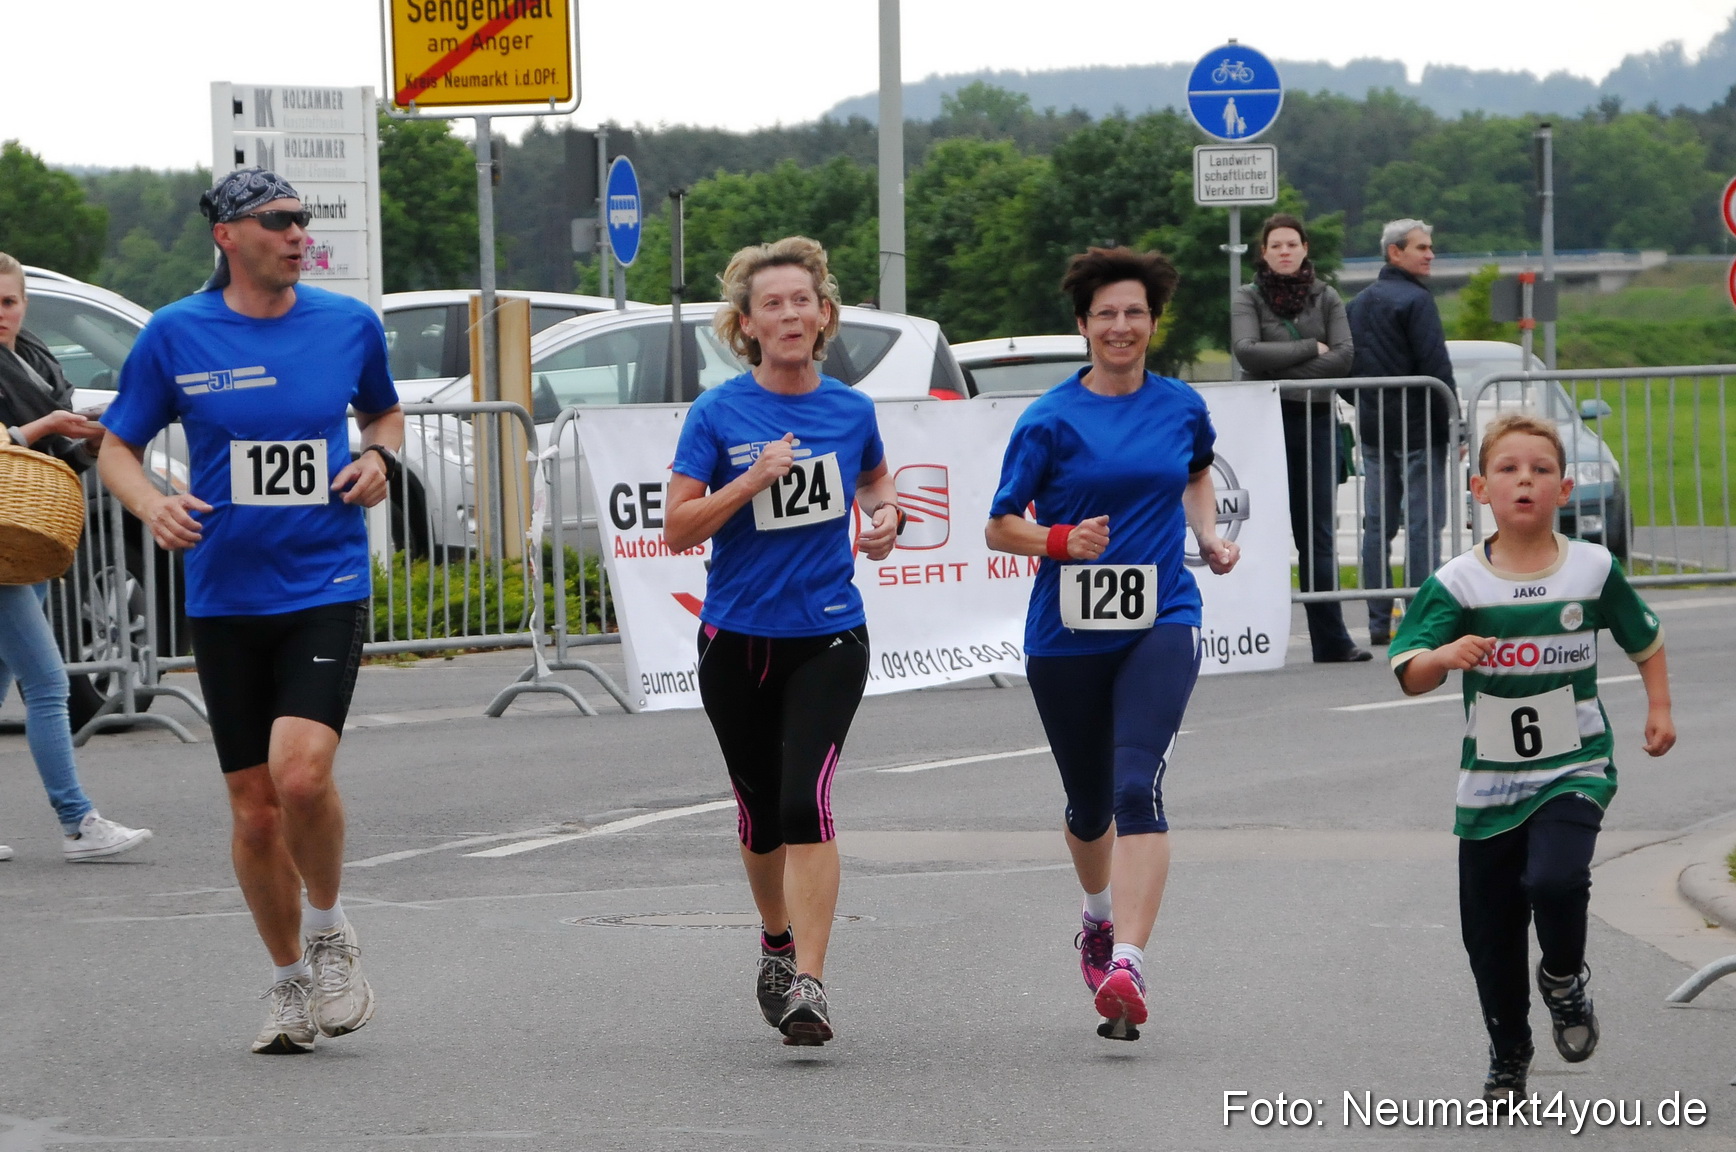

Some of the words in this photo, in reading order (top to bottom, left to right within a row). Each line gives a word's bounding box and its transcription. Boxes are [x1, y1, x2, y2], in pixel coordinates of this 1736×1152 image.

[407, 0, 553, 30] Sengenthal
[427, 37, 459, 52] am
[469, 33, 534, 56] Anger
[405, 72, 438, 90] Kreis
[444, 70, 508, 88] Neumarkt
[515, 68, 559, 86] i.d.OPf.
[282, 88, 344, 110] HOLZAMMER
[284, 138, 345, 159] HOLZAMMER
[1209, 154, 1262, 167] Landwirt-
[1204, 169, 1268, 182] schaftlicher
[1204, 184, 1245, 197] Verkehr
[1250, 182, 1269, 196] frei
[246, 443, 316, 496] 126
[769, 460, 831, 519] 124
[609, 482, 670, 530] GE
[878, 562, 969, 586] SEAT
[987, 556, 1020, 579] KIA
[1075, 567, 1145, 620] 128
[1513, 586, 1547, 599] JAKO
[881, 646, 974, 680] 09181/26
[969, 640, 1021, 664] 80-0
[1543, 643, 1590, 665] Direkt
[1510, 705, 1544, 758] 6
